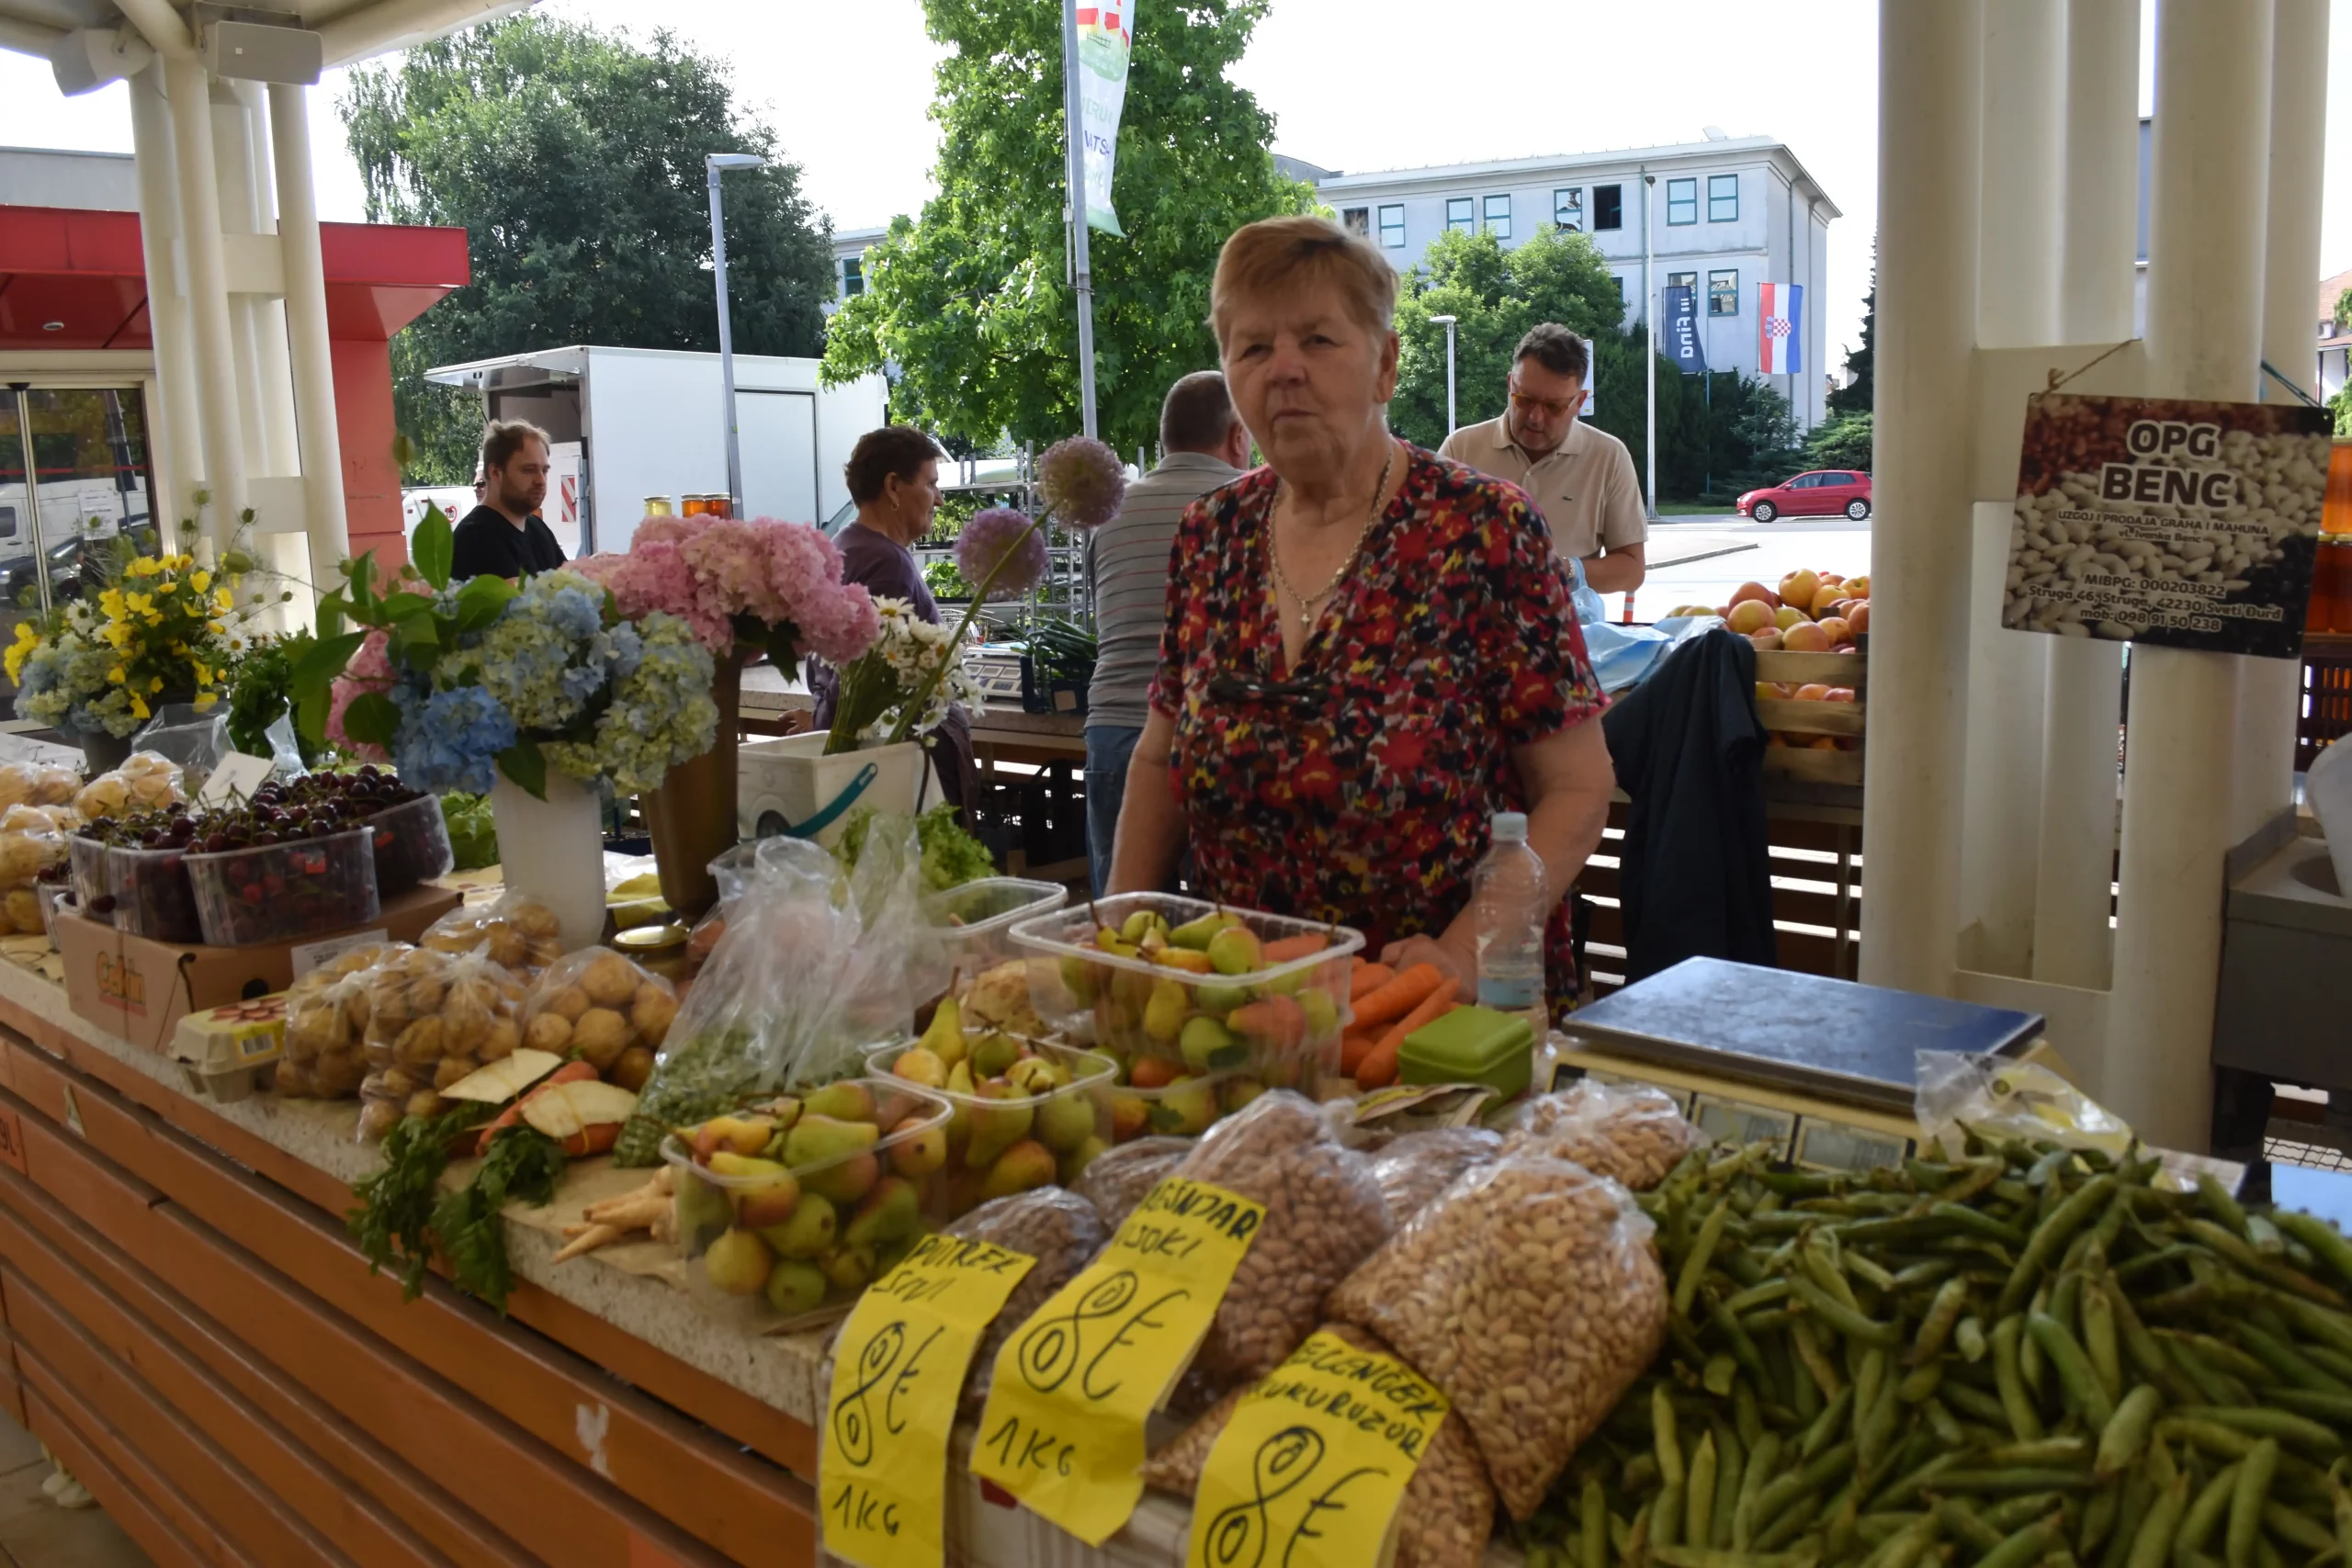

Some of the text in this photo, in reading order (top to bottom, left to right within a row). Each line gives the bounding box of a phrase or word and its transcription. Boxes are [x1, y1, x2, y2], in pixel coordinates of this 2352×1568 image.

[2129, 422, 2219, 458] OPG
[2101, 465, 2233, 508] BENC
[2058, 511, 2095, 523] UZGOJ
[2103, 513, 2157, 527] PRODAJA
[2160, 517, 2203, 531] GRAHA
[2212, 522, 2270, 536] MAHUNA
[2175, 532, 2202, 544] Benc
[2084, 574, 2226, 597] MIBPG: 000203822
[2028, 585, 2074, 602] Struga
[2155, 597, 2202, 613] 42230
[2205, 601, 2242, 616] Sveti
[2079, 607, 2222, 632] mob: 098 91 50 238
